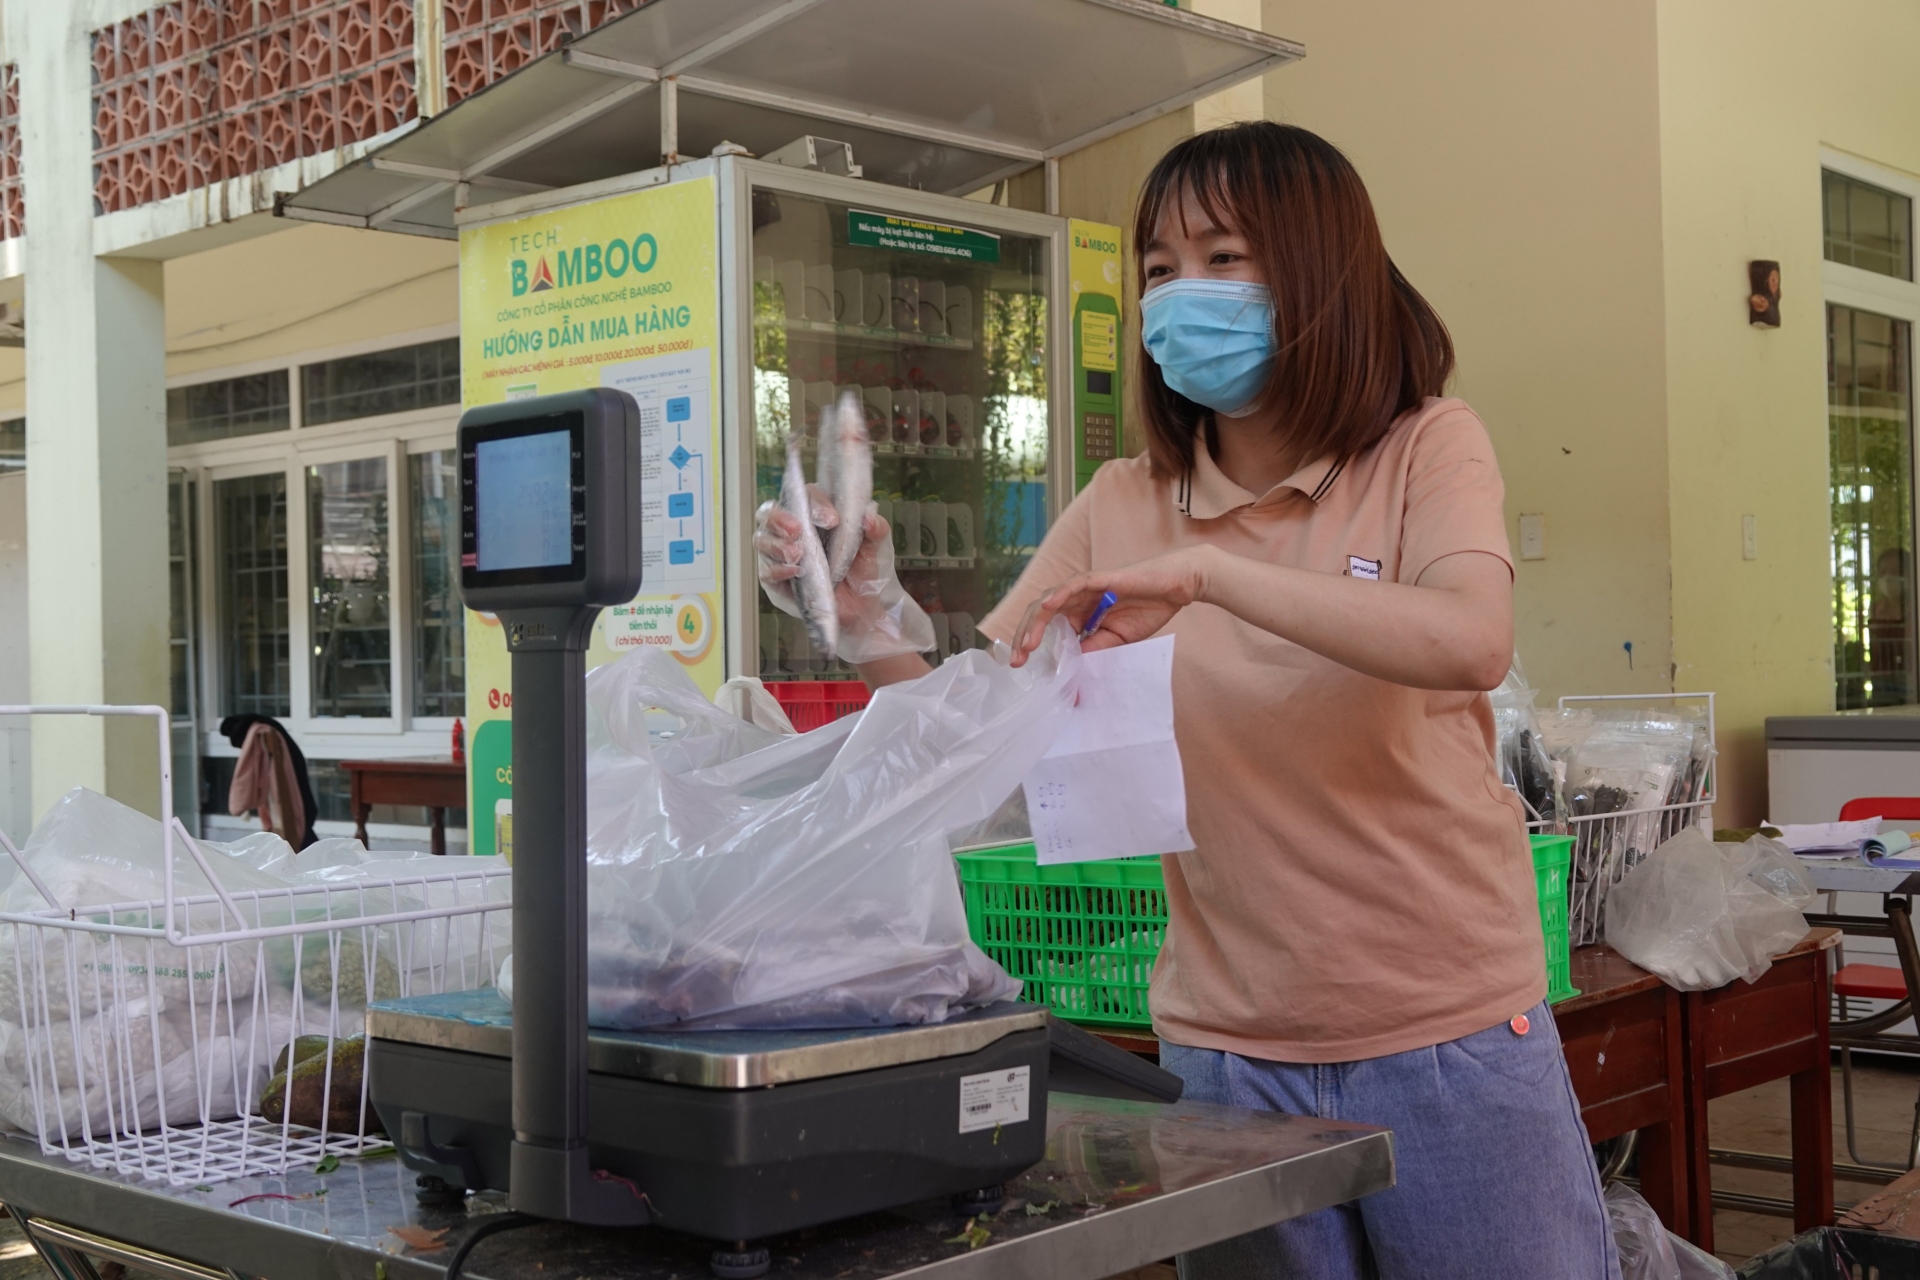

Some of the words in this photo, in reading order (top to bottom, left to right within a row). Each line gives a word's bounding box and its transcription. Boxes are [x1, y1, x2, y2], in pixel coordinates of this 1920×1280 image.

[510, 229, 557, 253] TECH
[1075, 236, 1116, 254] BAMBOO
[511, 233, 658, 297] BAMBOO
[497, 308, 521, 322] CÔNG
[522, 307, 532, 317] TY
[534, 299, 546, 316] CỔ
[548, 296, 573, 312] PHẦN
[574, 293, 600, 308] CÔNG
[602, 286, 627, 303] NGHỆ
[629, 281, 672, 299] BAMBOO
[484, 328, 543, 359] HƯỚNG
[548, 315, 584, 348] DẪN
[590, 315, 629, 342] MUA
[635, 304, 690, 334] HÀNG
[646, 605, 664, 617] nhận
[665, 604, 673, 617] lại
[683, 613, 695, 634] 4
[645, 634, 673, 646] 10.000)
[171, 968, 188, 978] 255
